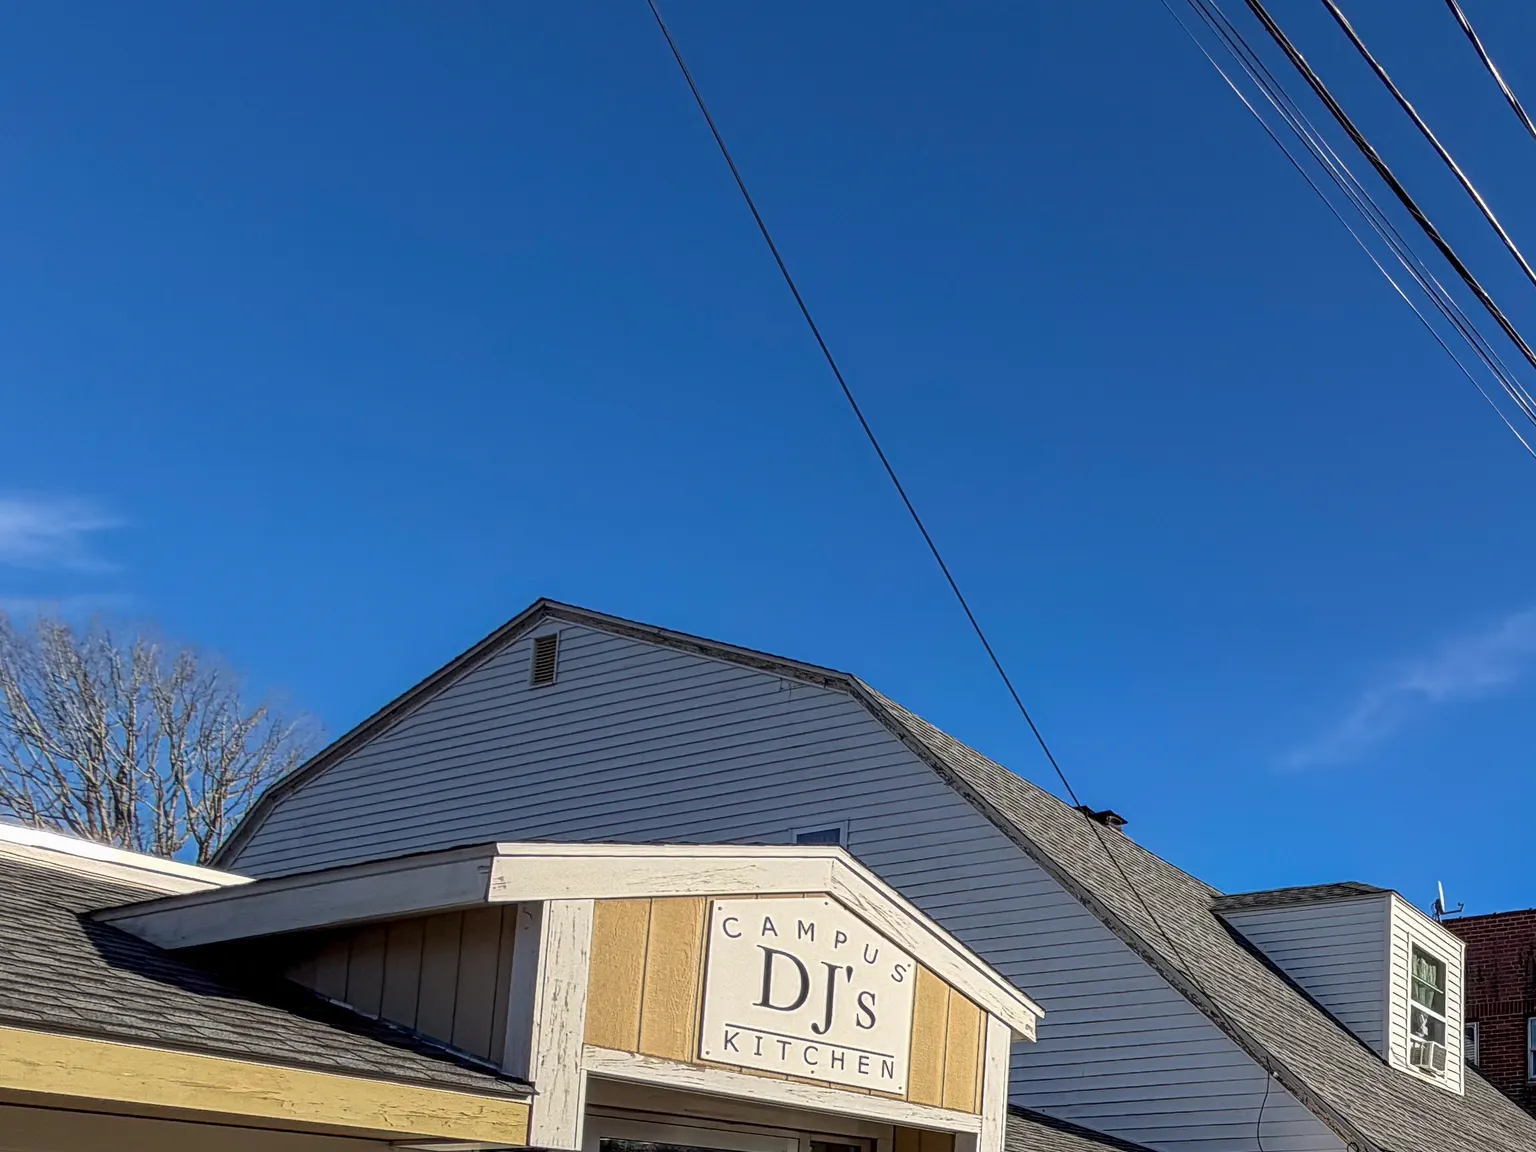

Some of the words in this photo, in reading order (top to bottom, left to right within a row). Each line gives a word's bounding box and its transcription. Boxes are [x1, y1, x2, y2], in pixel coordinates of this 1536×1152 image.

[722, 916, 907, 983] CAMPUS
[752, 944, 877, 1036] DJ's
[723, 1030, 895, 1079] KITCHEN
